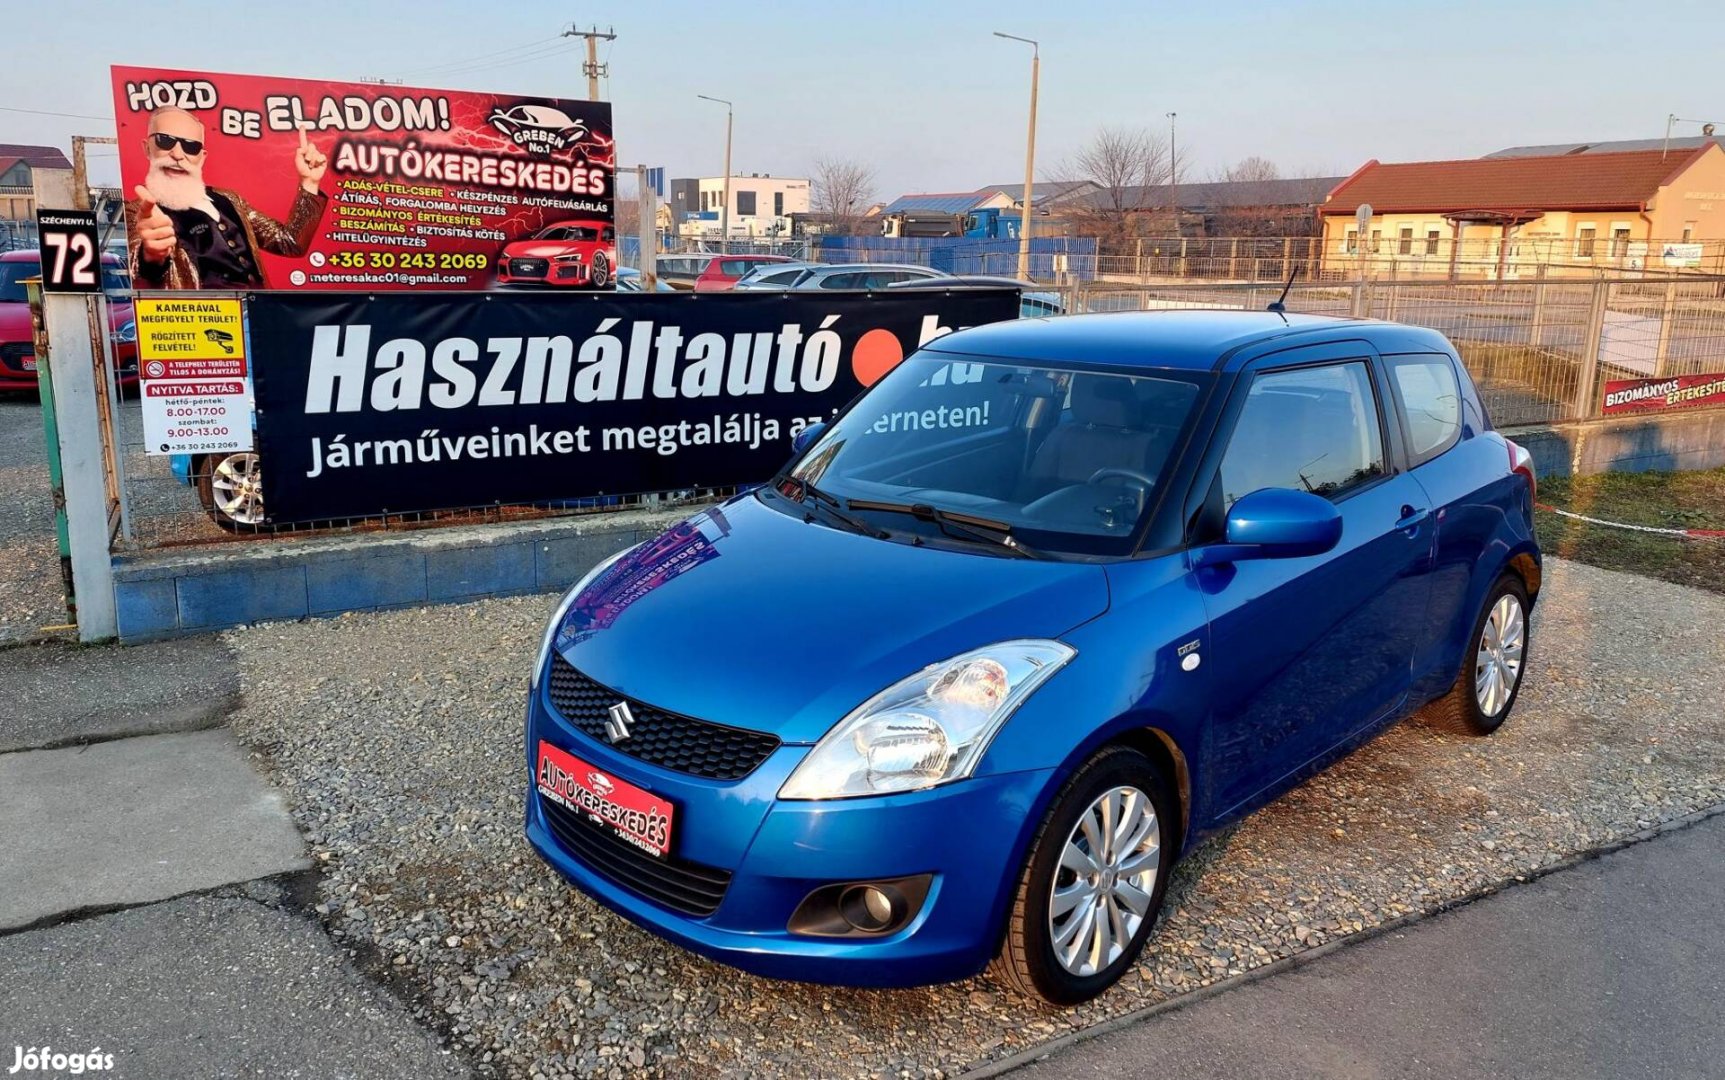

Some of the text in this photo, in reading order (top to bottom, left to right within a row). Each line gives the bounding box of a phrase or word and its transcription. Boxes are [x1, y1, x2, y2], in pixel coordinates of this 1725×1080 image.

[126, 81, 217, 111] HOZD
[266, 96, 449, 131] ELADOM!
[221, 109, 261, 138] BE
[513, 130, 564, 148] GREBEN
[529, 143, 550, 153] No.1
[336, 142, 604, 195] AUTÓKERESKEDÉS
[343, 180, 443, 197] ADÁS-VÉTEL-CSERE
[341, 191, 506, 216] ÁTÍRÁS, FORGALOMBA HELYEZÉS
[457, 190, 608, 212] KÉSZPÉNZES AUTÓFELVÁSÁRLÁS
[40, 216, 84, 226] SZÉCHENYI
[340, 206, 482, 226] BIZOMÁNYOS ÉRTÉKESÍTÉS
[340, 219, 505, 240] BESZÁMÍTÁS BIZTOSÍTÁS KÖTÉS
[44, 232, 95, 284] 72
[329, 252, 487, 269] +36 30 243 2069
[156, 303, 221, 313] KAMERÁVAL
[141, 314, 237, 323] MEGFIGYELT TERÜLET!
[151, 331, 196, 341] RÖGZÍTETT
[153, 342, 196, 352] FELVÉTEL!
[151, 382, 239, 395] NYITVA TARTÁS:
[1606, 380, 1679, 407] BIZOMÁNYOS
[166, 407, 226, 417] 8.00-17.00
[178, 418, 217, 426] szombat:
[167, 427, 229, 438] 9.00-13.00
[306, 424, 591, 478] Járműveinket
[602, 412, 779, 456] megtalálja
[541, 756, 668, 848] AUTÓKERESKEDÉS
